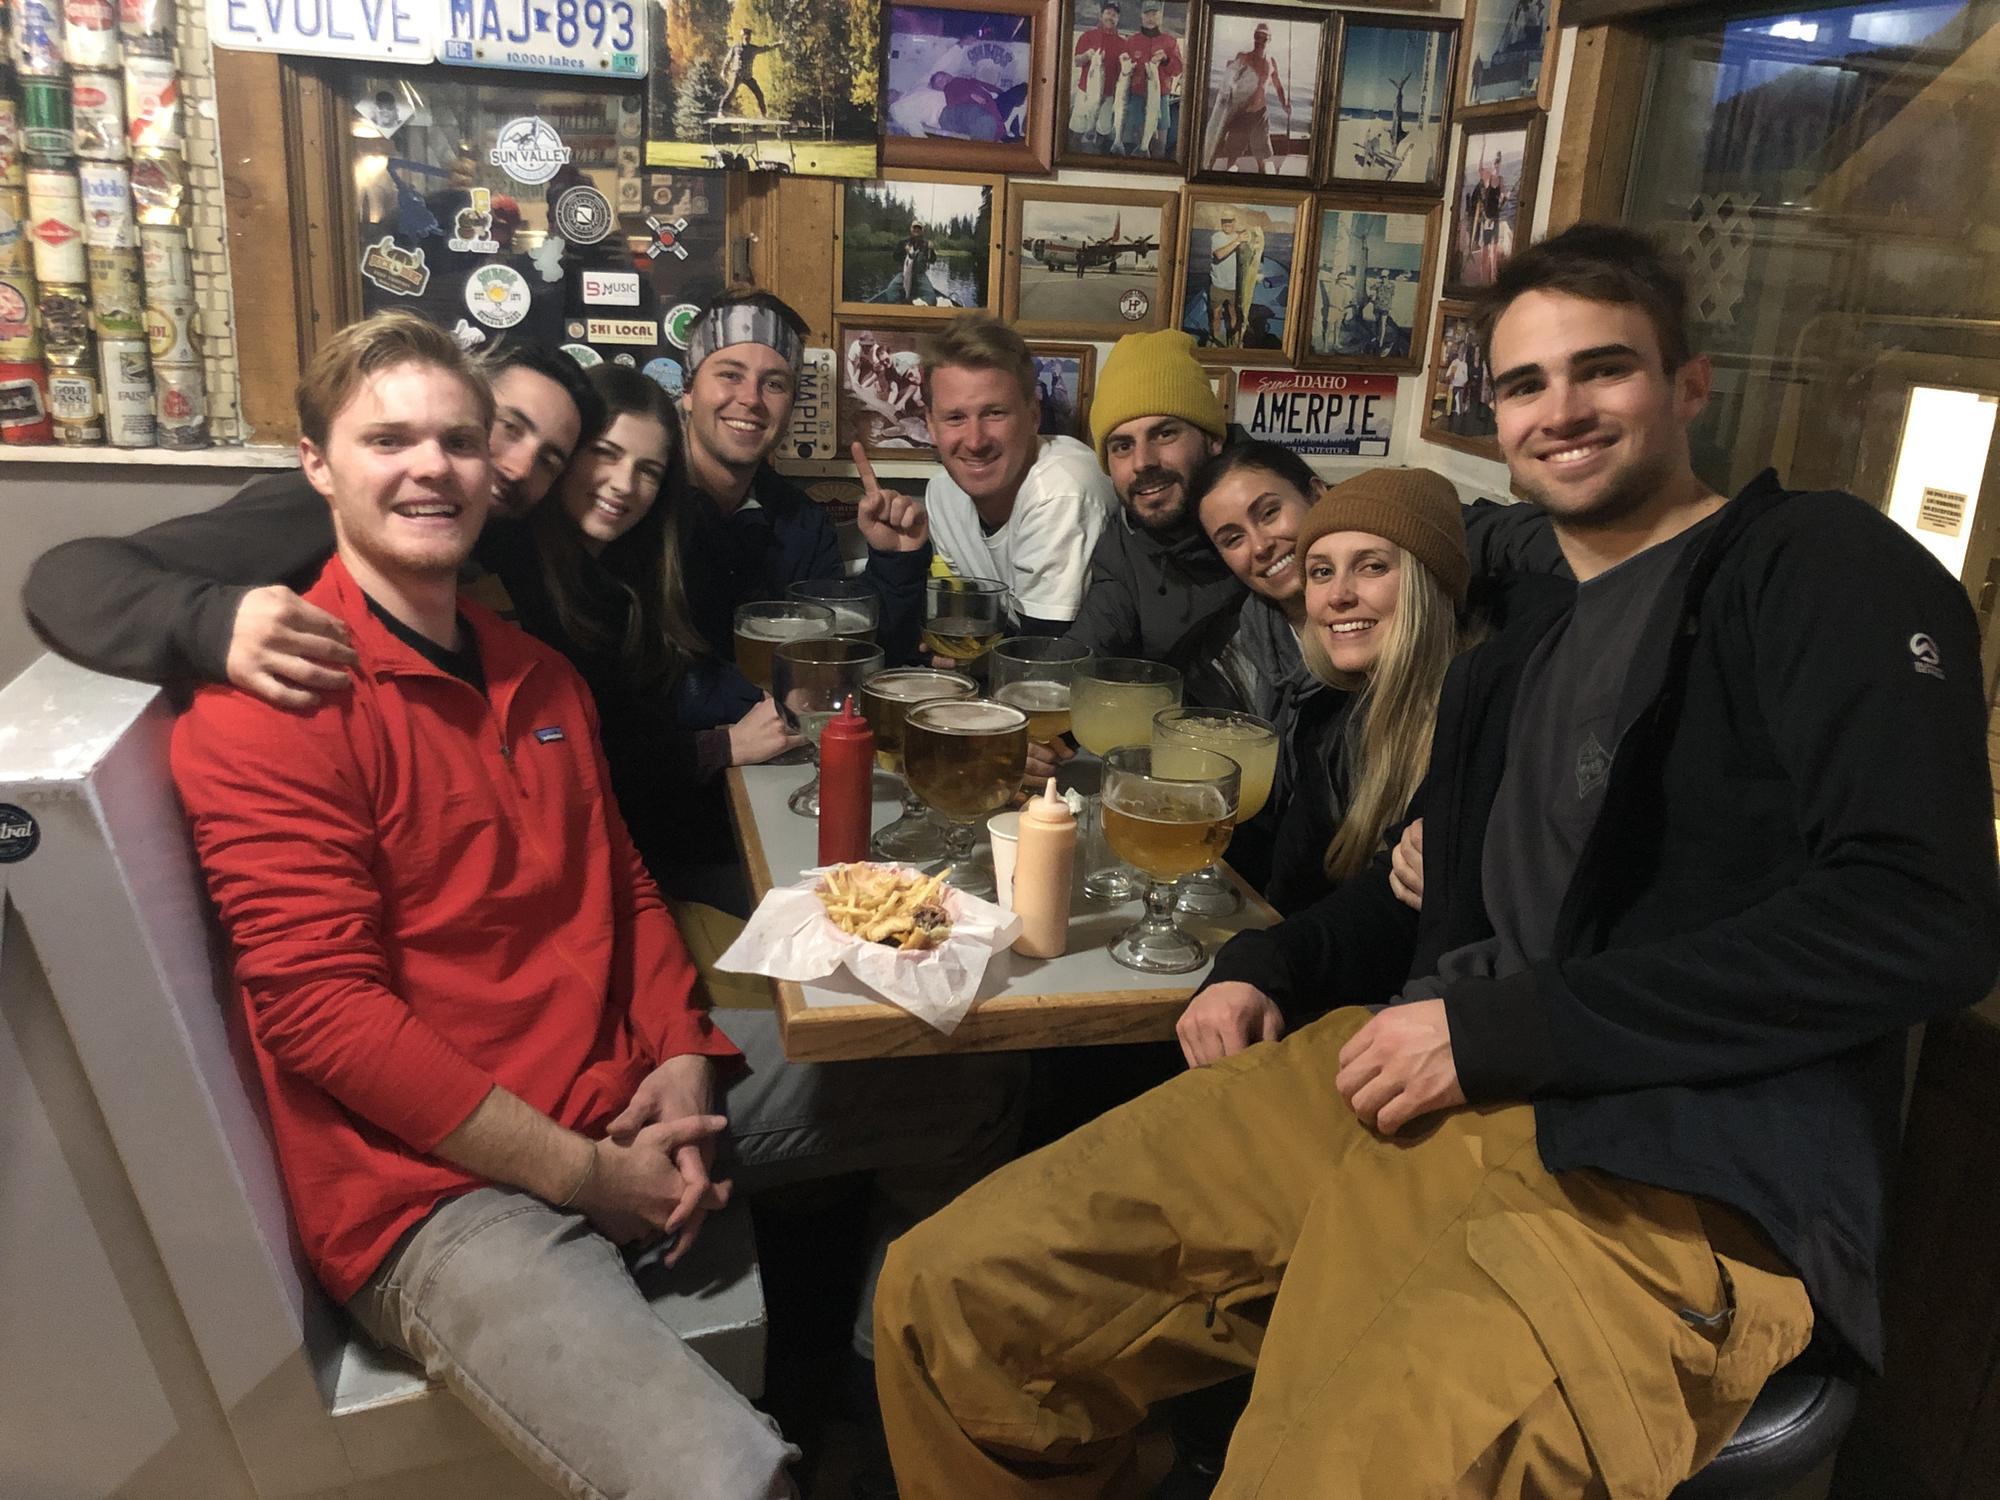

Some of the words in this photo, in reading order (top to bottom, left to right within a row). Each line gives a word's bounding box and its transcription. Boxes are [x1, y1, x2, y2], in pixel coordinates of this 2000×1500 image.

[228, 0, 420, 44] EVOLVE
[450, 0, 529, 43] MAJ
[556, 0, 635, 51] 893
[550, 56, 585, 69] lakes
[492, 150, 518, 164] SUN
[520, 148, 570, 163] VALLEY
[602, 282, 637, 296] MUSIC
[590, 324, 611, 335] SKI
[615, 325, 653, 337] LOCAL
[820, 362, 830, 409] CYCLE
[1294, 374, 1347, 389] IDAHO
[1251, 392, 1381, 435] AMERPIE
